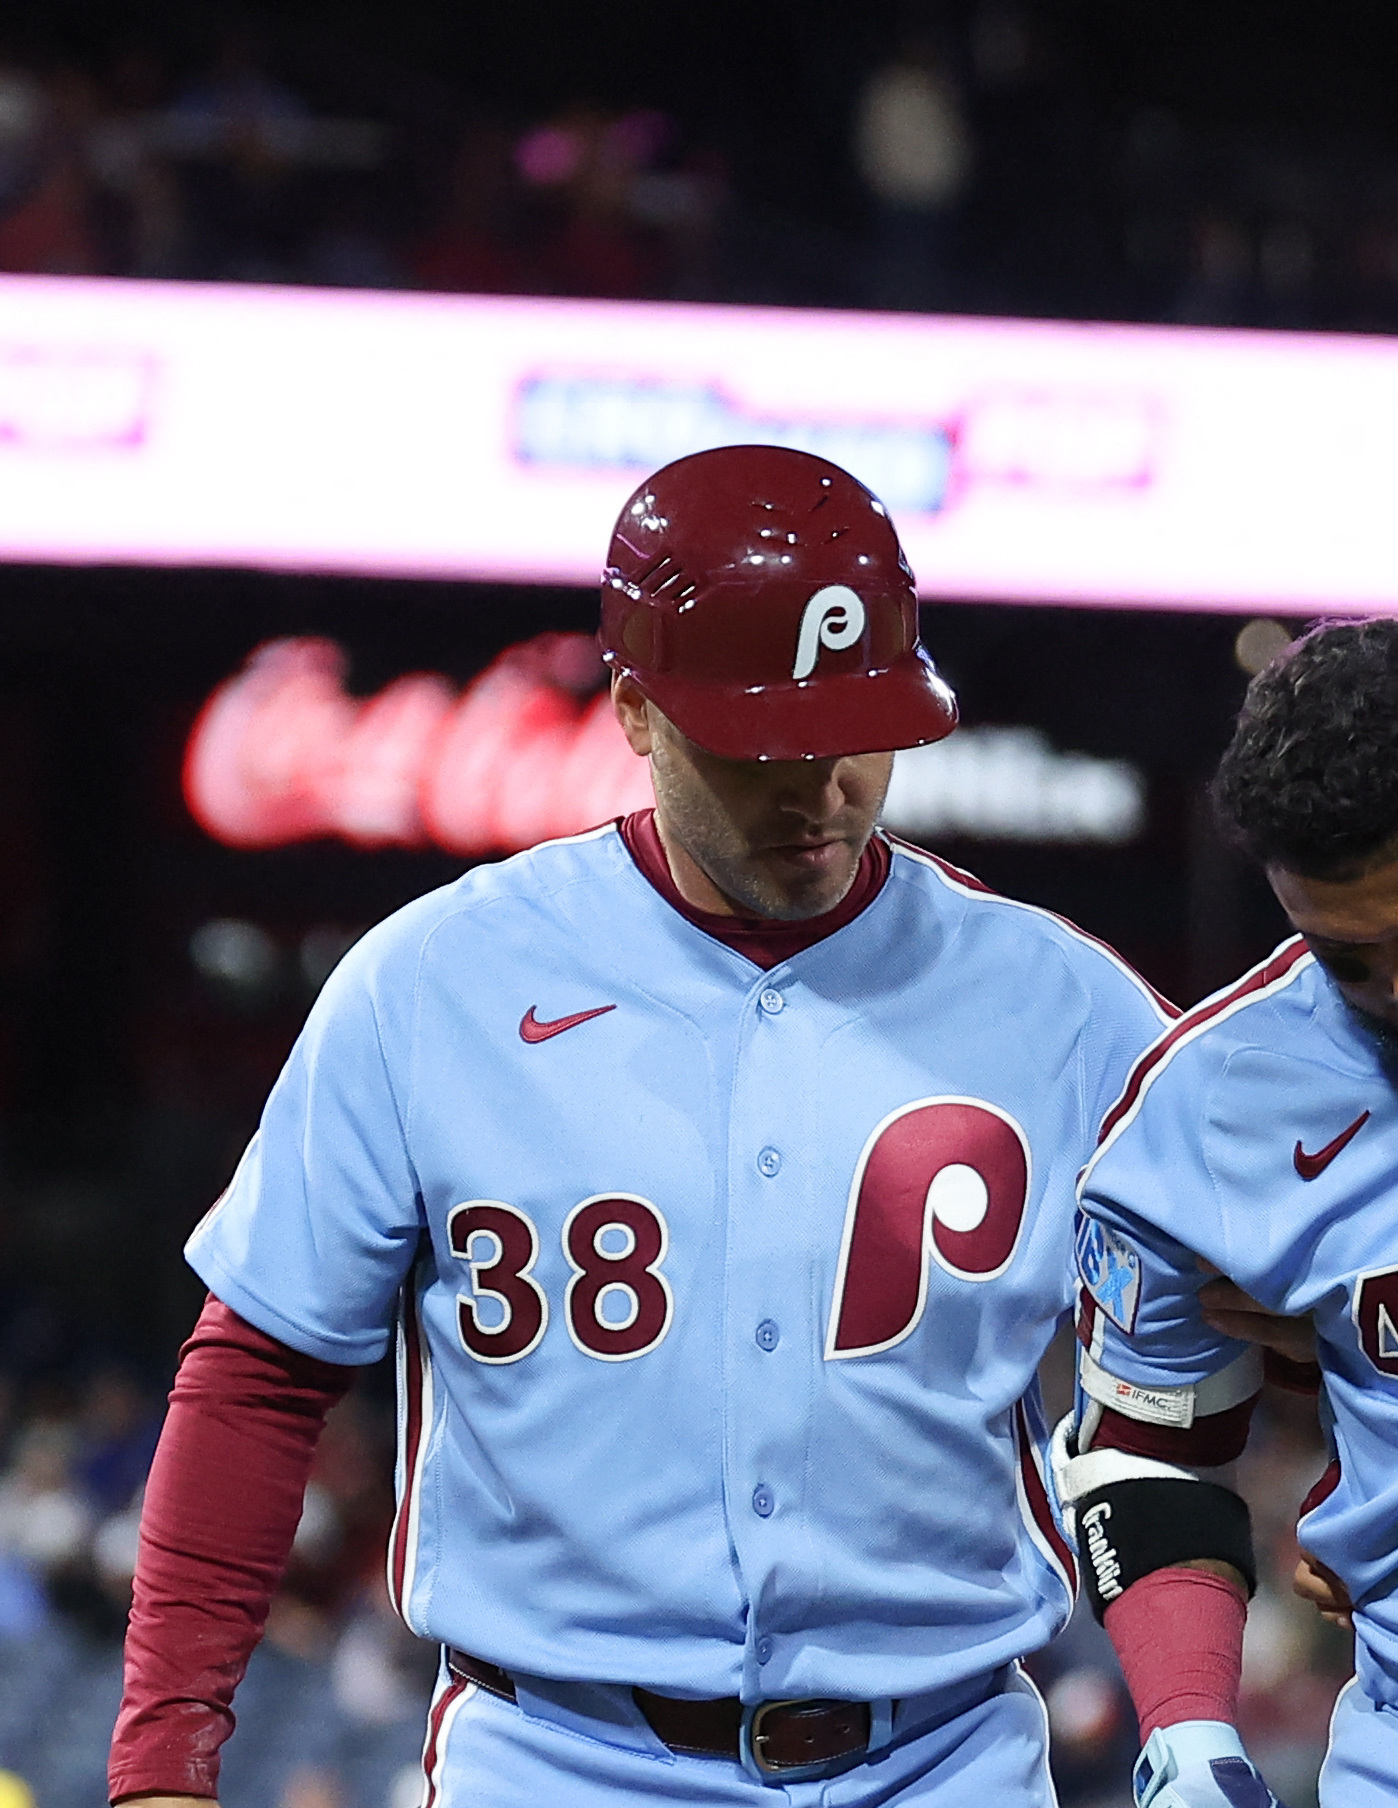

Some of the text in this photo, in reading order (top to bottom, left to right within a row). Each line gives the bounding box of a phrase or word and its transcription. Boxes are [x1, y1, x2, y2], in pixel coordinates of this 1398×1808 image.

[792, 585, 866, 680] P
[447, 1191, 674, 1364] 38
[824, 1094, 1032, 1361] P
